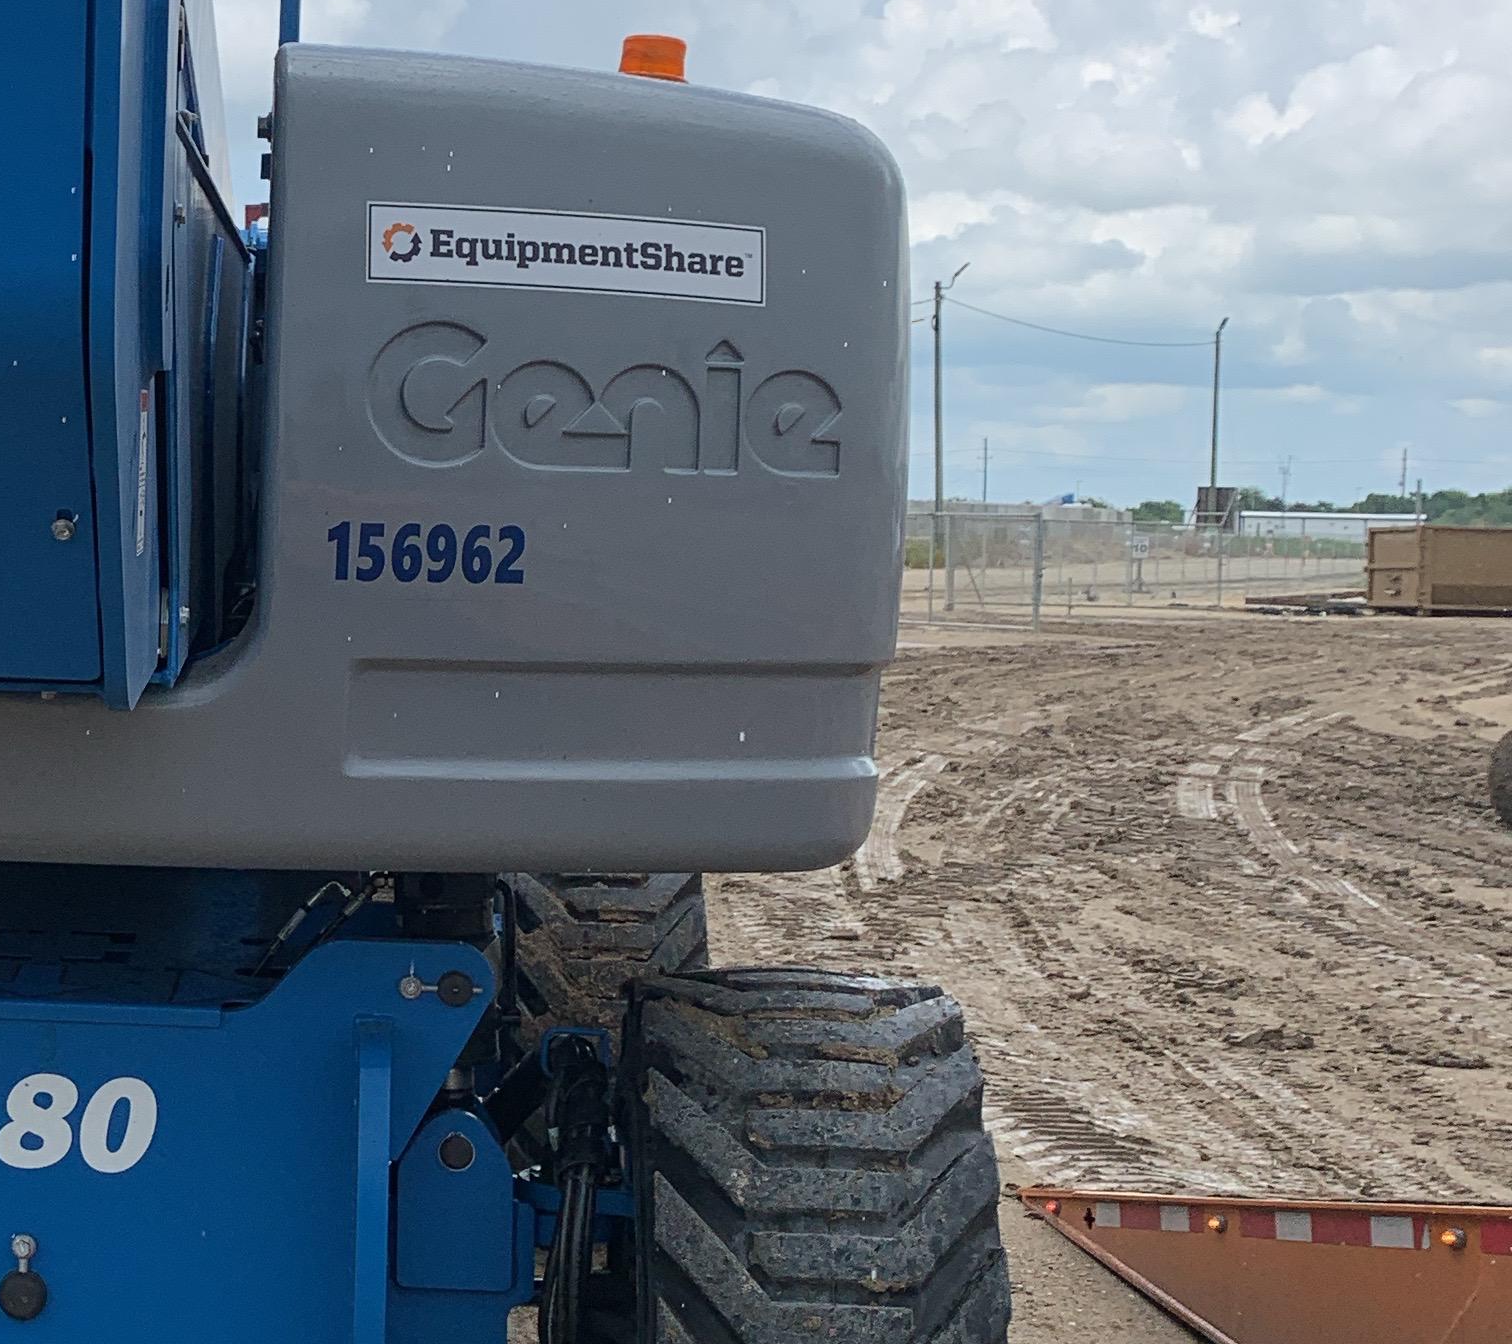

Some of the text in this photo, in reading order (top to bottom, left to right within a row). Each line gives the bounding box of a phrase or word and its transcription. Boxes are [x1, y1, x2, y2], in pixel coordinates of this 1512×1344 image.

[429, 228, 745, 278] EquipmentShare
[366, 320, 843, 480] Genie
[327, 520, 526, 585] 156962
